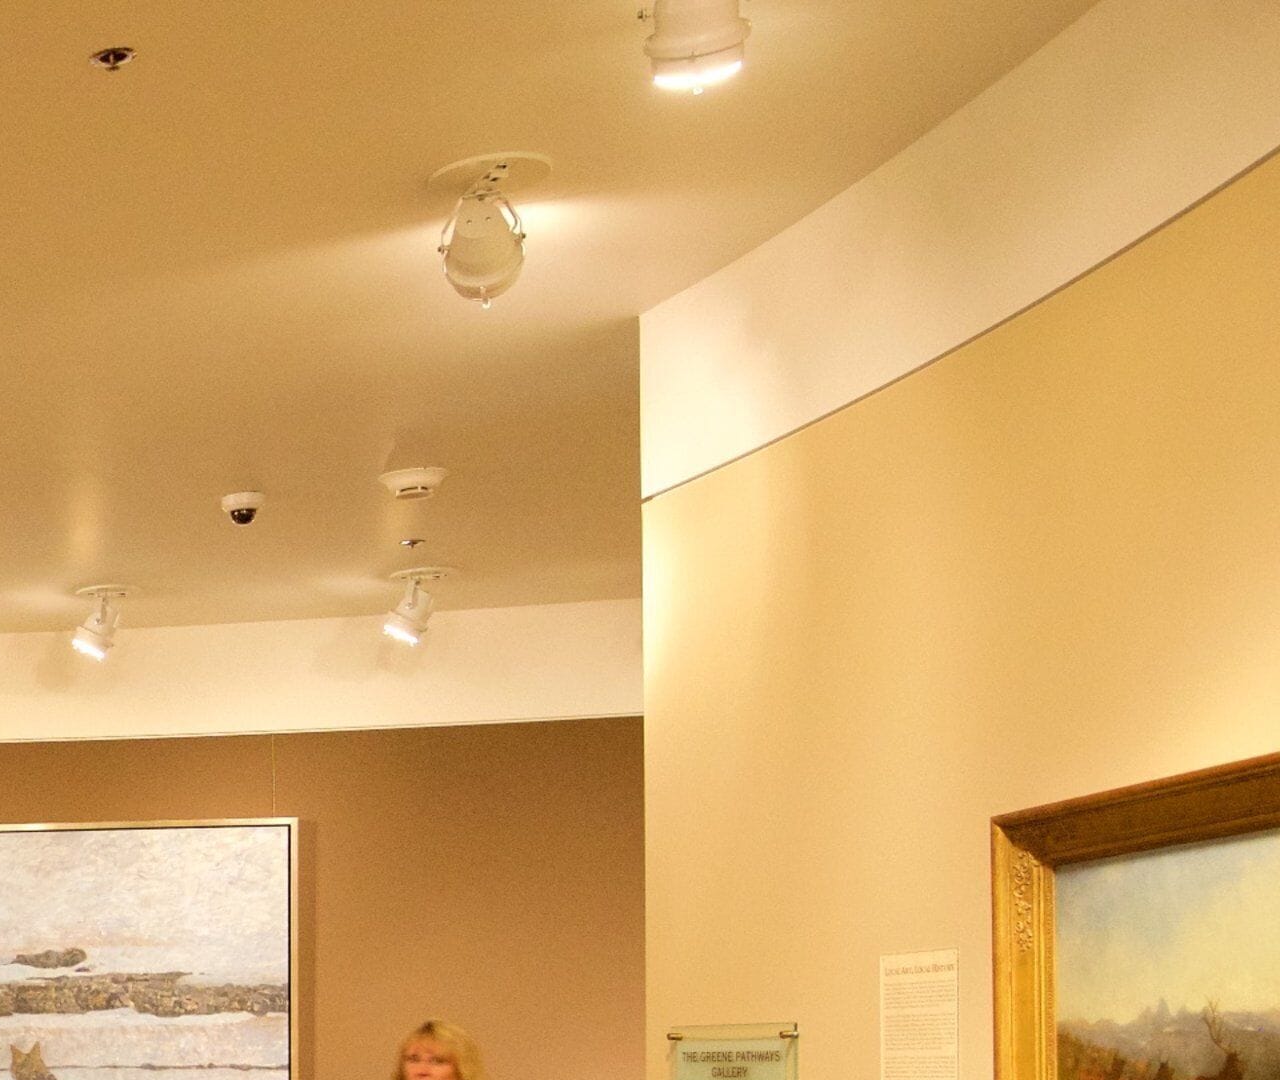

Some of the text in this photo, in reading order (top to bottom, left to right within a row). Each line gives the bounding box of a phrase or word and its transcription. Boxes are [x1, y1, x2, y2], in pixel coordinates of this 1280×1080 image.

[682, 1051, 780, 1062] THE GREENE PATHWAYS
[711, 1066, 748, 1078] GALLERY
